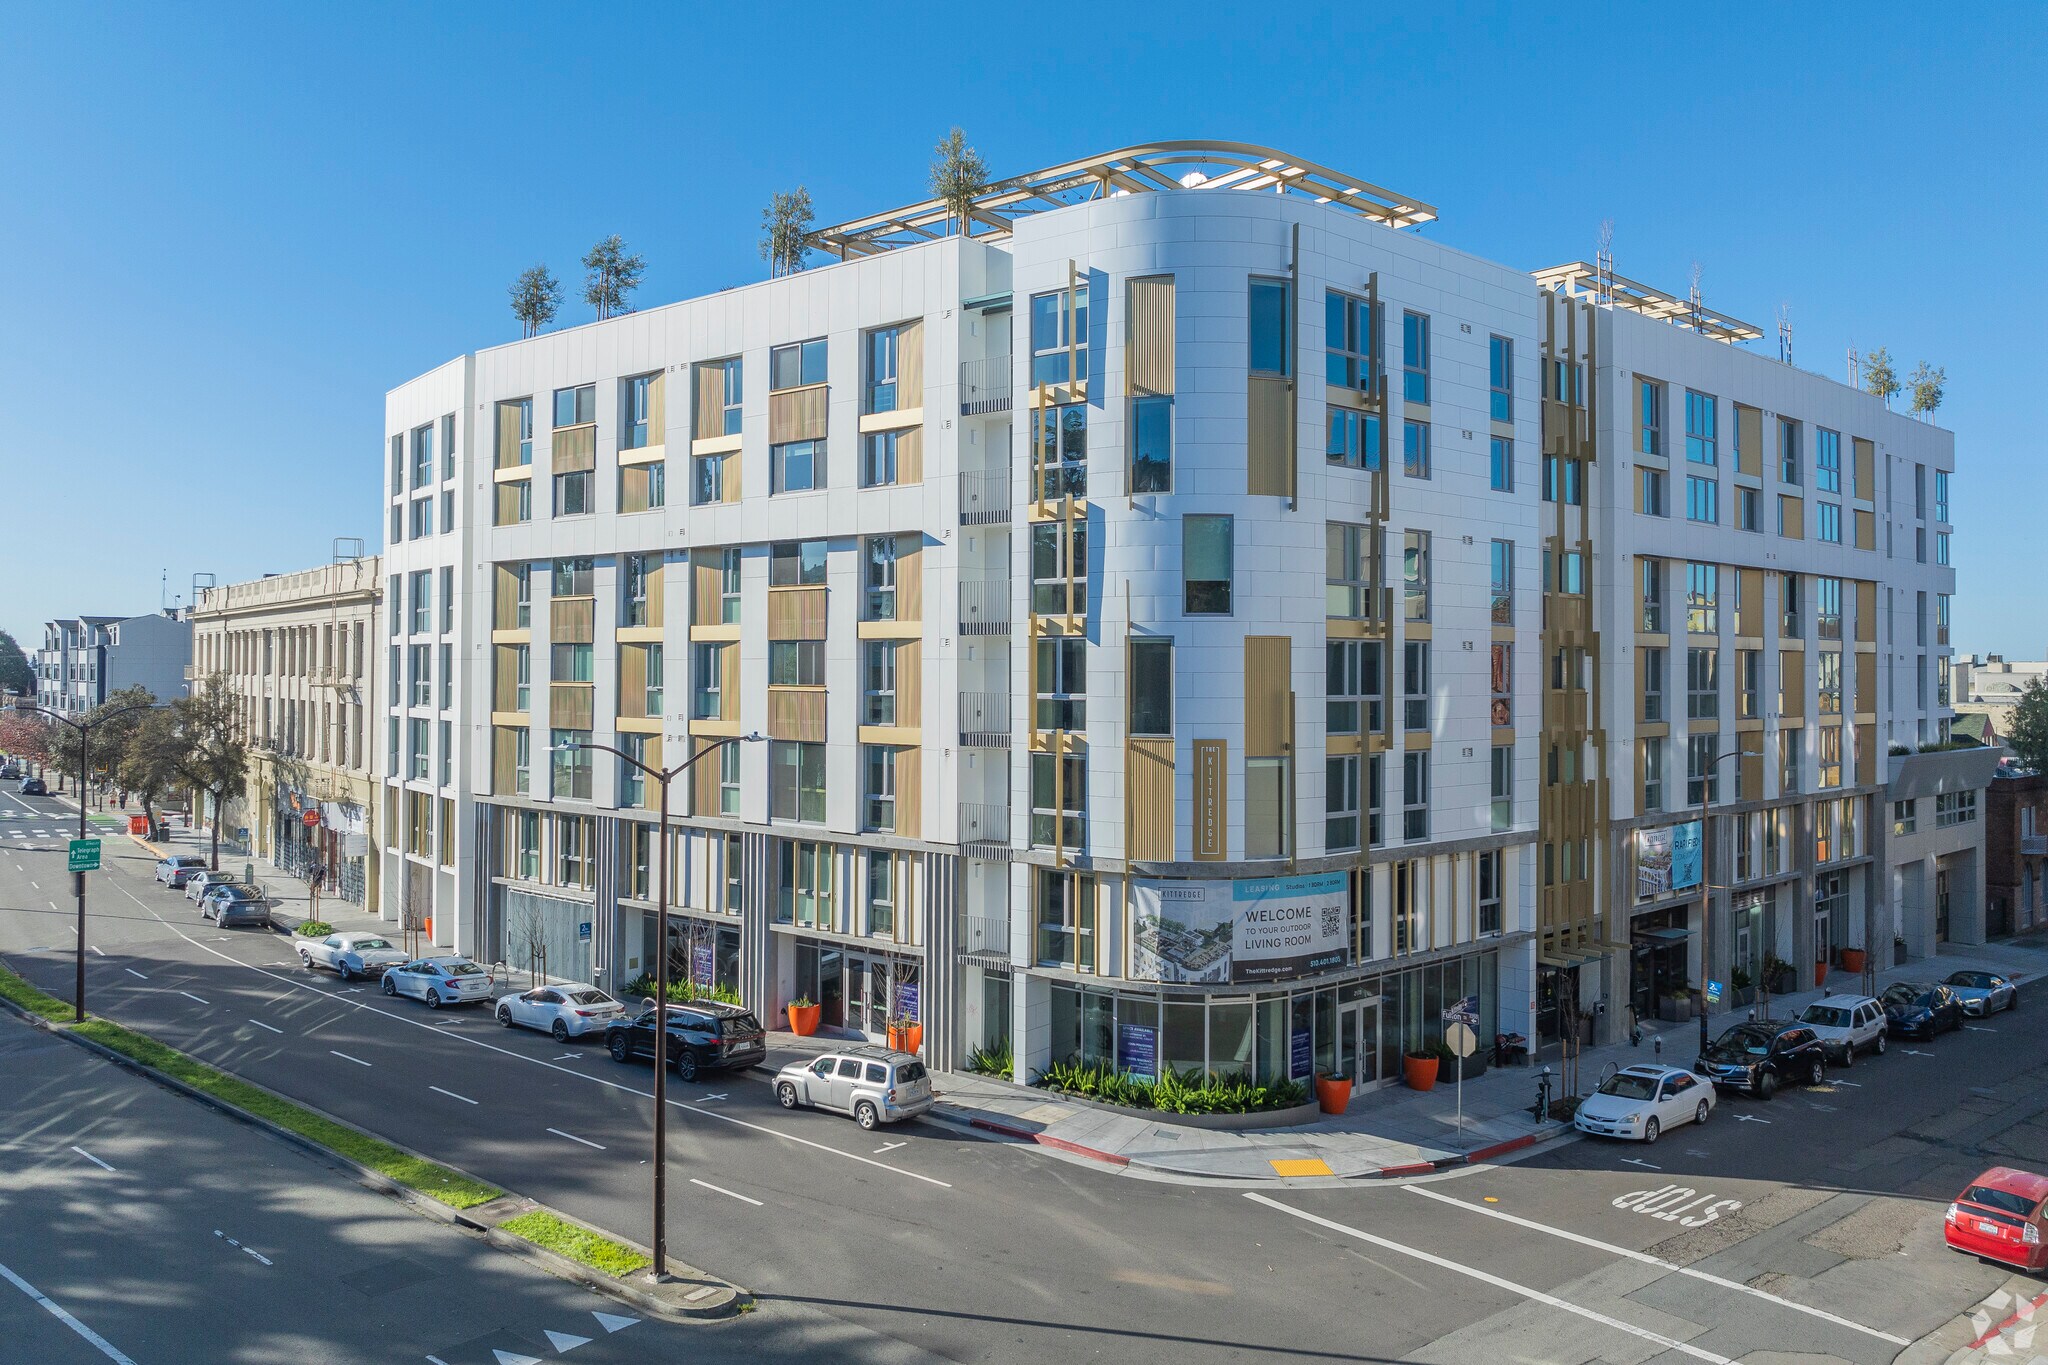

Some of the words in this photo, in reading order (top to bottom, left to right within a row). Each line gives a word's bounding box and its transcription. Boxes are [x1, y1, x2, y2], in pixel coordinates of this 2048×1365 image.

[1162, 890, 1201, 898] KITTREDGE
[1245, 884, 1280, 893] LEASING
[1245, 906, 1312, 922] WELCOME
[1258, 926, 1278, 934] YOUR
[1280, 923, 1312, 933] OUTDOOR
[1245, 937, 1281, 949] LIVING
[1284, 935, 1312, 947] ROOM
[1245, 966, 1293, 974] TheKittredge.com
[1612, 1184, 1743, 1227] STOP
